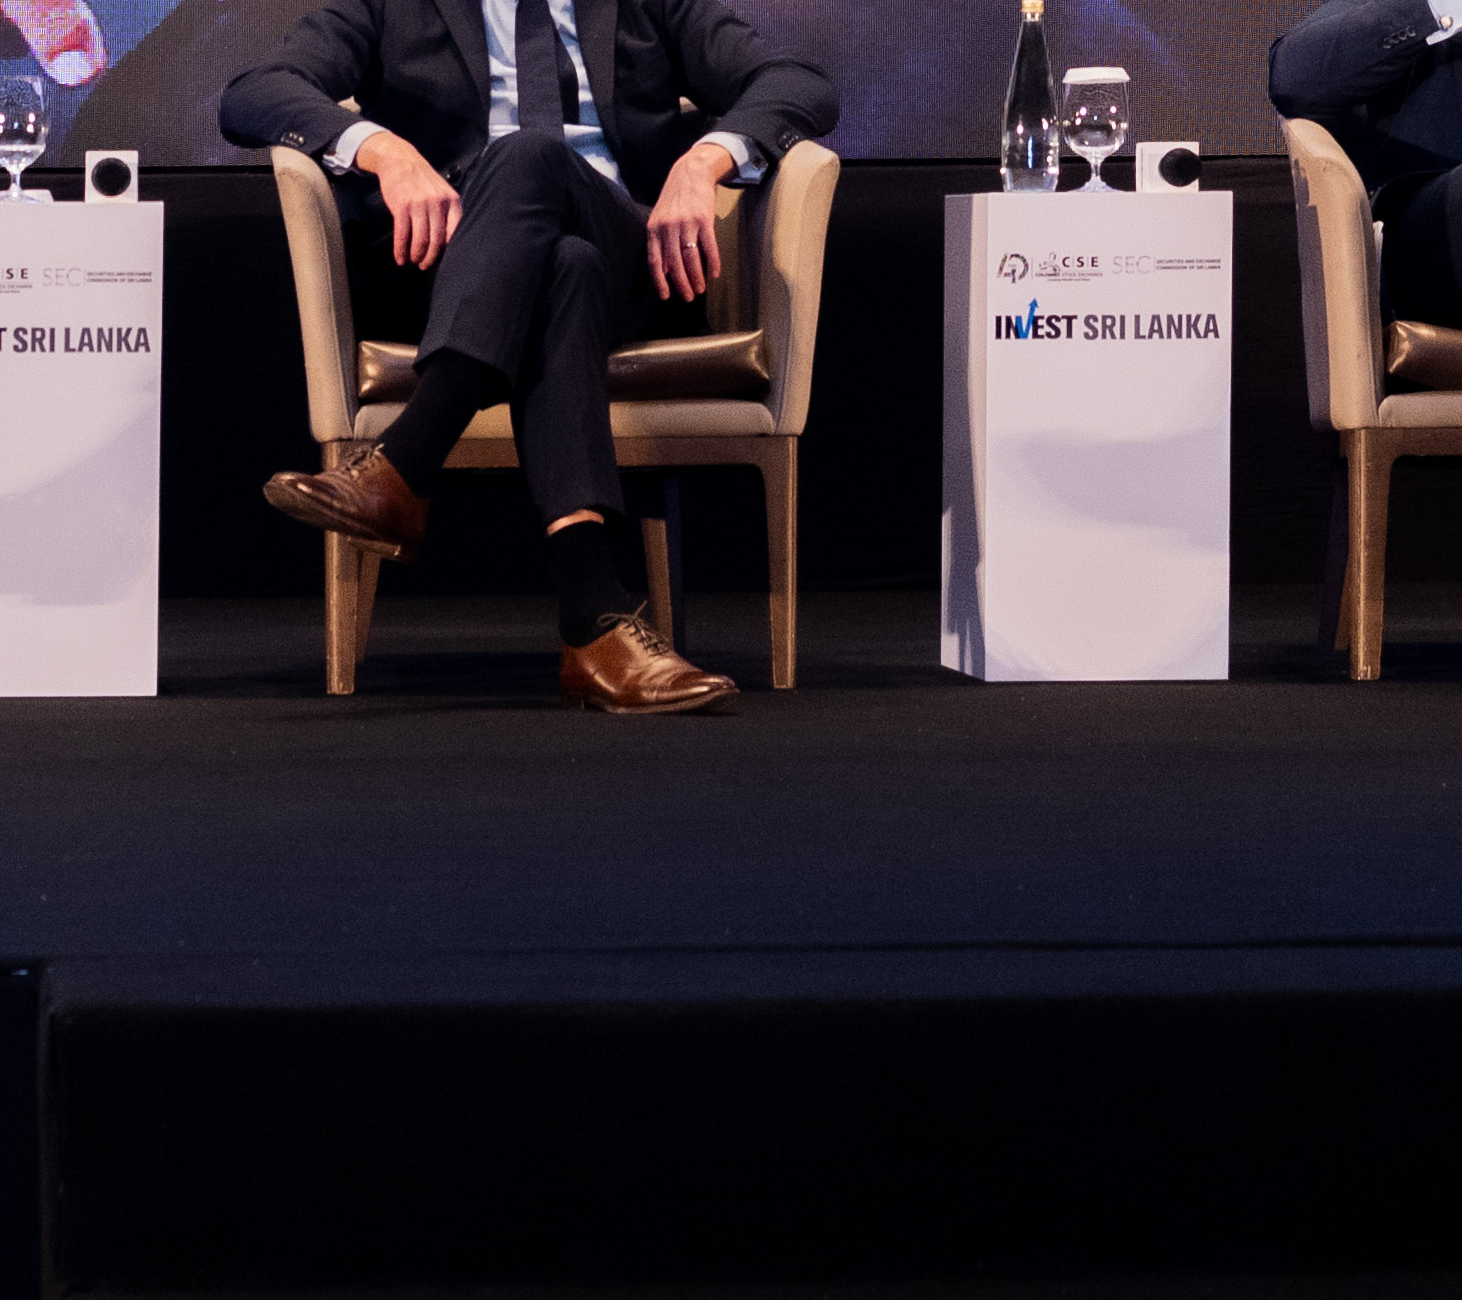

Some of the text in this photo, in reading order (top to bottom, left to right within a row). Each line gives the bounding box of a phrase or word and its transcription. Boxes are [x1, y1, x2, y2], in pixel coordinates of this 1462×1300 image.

[1112, 255, 1151, 274] SEC
[42, 267, 81, 287] SEC
[995, 298, 1220, 340] INVEST SRI LANKA
[13, 327, 55, 353] SRI
[64, 327, 151, 353] LANKA
